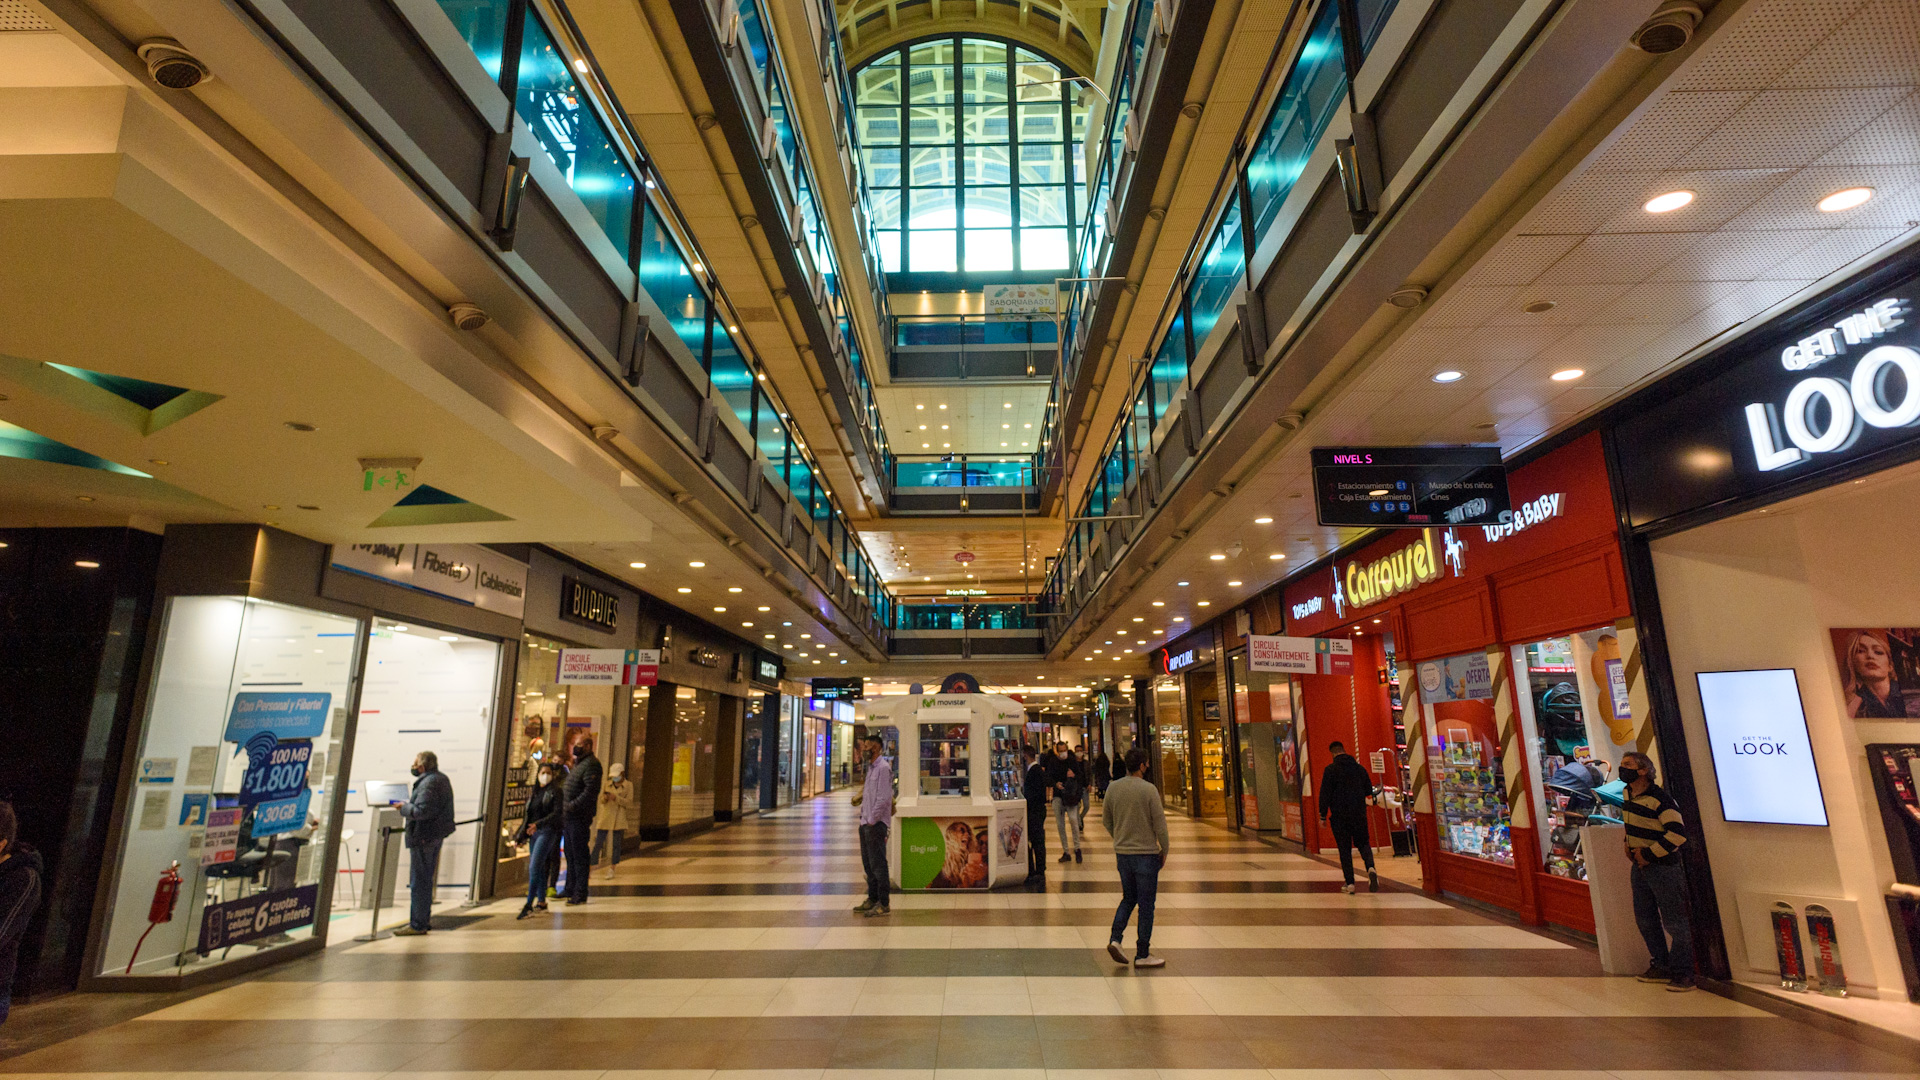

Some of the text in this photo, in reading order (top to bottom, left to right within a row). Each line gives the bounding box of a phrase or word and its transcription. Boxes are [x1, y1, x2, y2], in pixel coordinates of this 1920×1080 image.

[1781, 298, 1904, 371] GET THE
[1745, 345, 1920, 471] LOO
[1334, 454, 1373, 464] NIVEL S
[1338, 482, 1406, 490] Estacionamiento E1
[1339, 493, 1411, 502] Caja Estacionamiento
[1522, 493, 1560, 525] BABY
[423, 551, 464, 579] Fibertel
[1346, 527, 1436, 604] Carrousel
[480, 571, 522, 598] Cablevisión
[573, 584, 619, 628] BUDDIES
[1253, 640, 1280, 650] CIRCULE
[564, 654, 590, 663] CIRCULE
[1253, 650, 1312, 661] CONSTANTEMENTE.
[270, 747, 309, 765] 100 MB
[1733, 743, 1788, 755] LOOK
[245, 763, 304, 794] $1.800
[271, 897, 299, 913] cuotas
[254, 900, 270, 932] 6
[268, 912, 282, 927] sin
